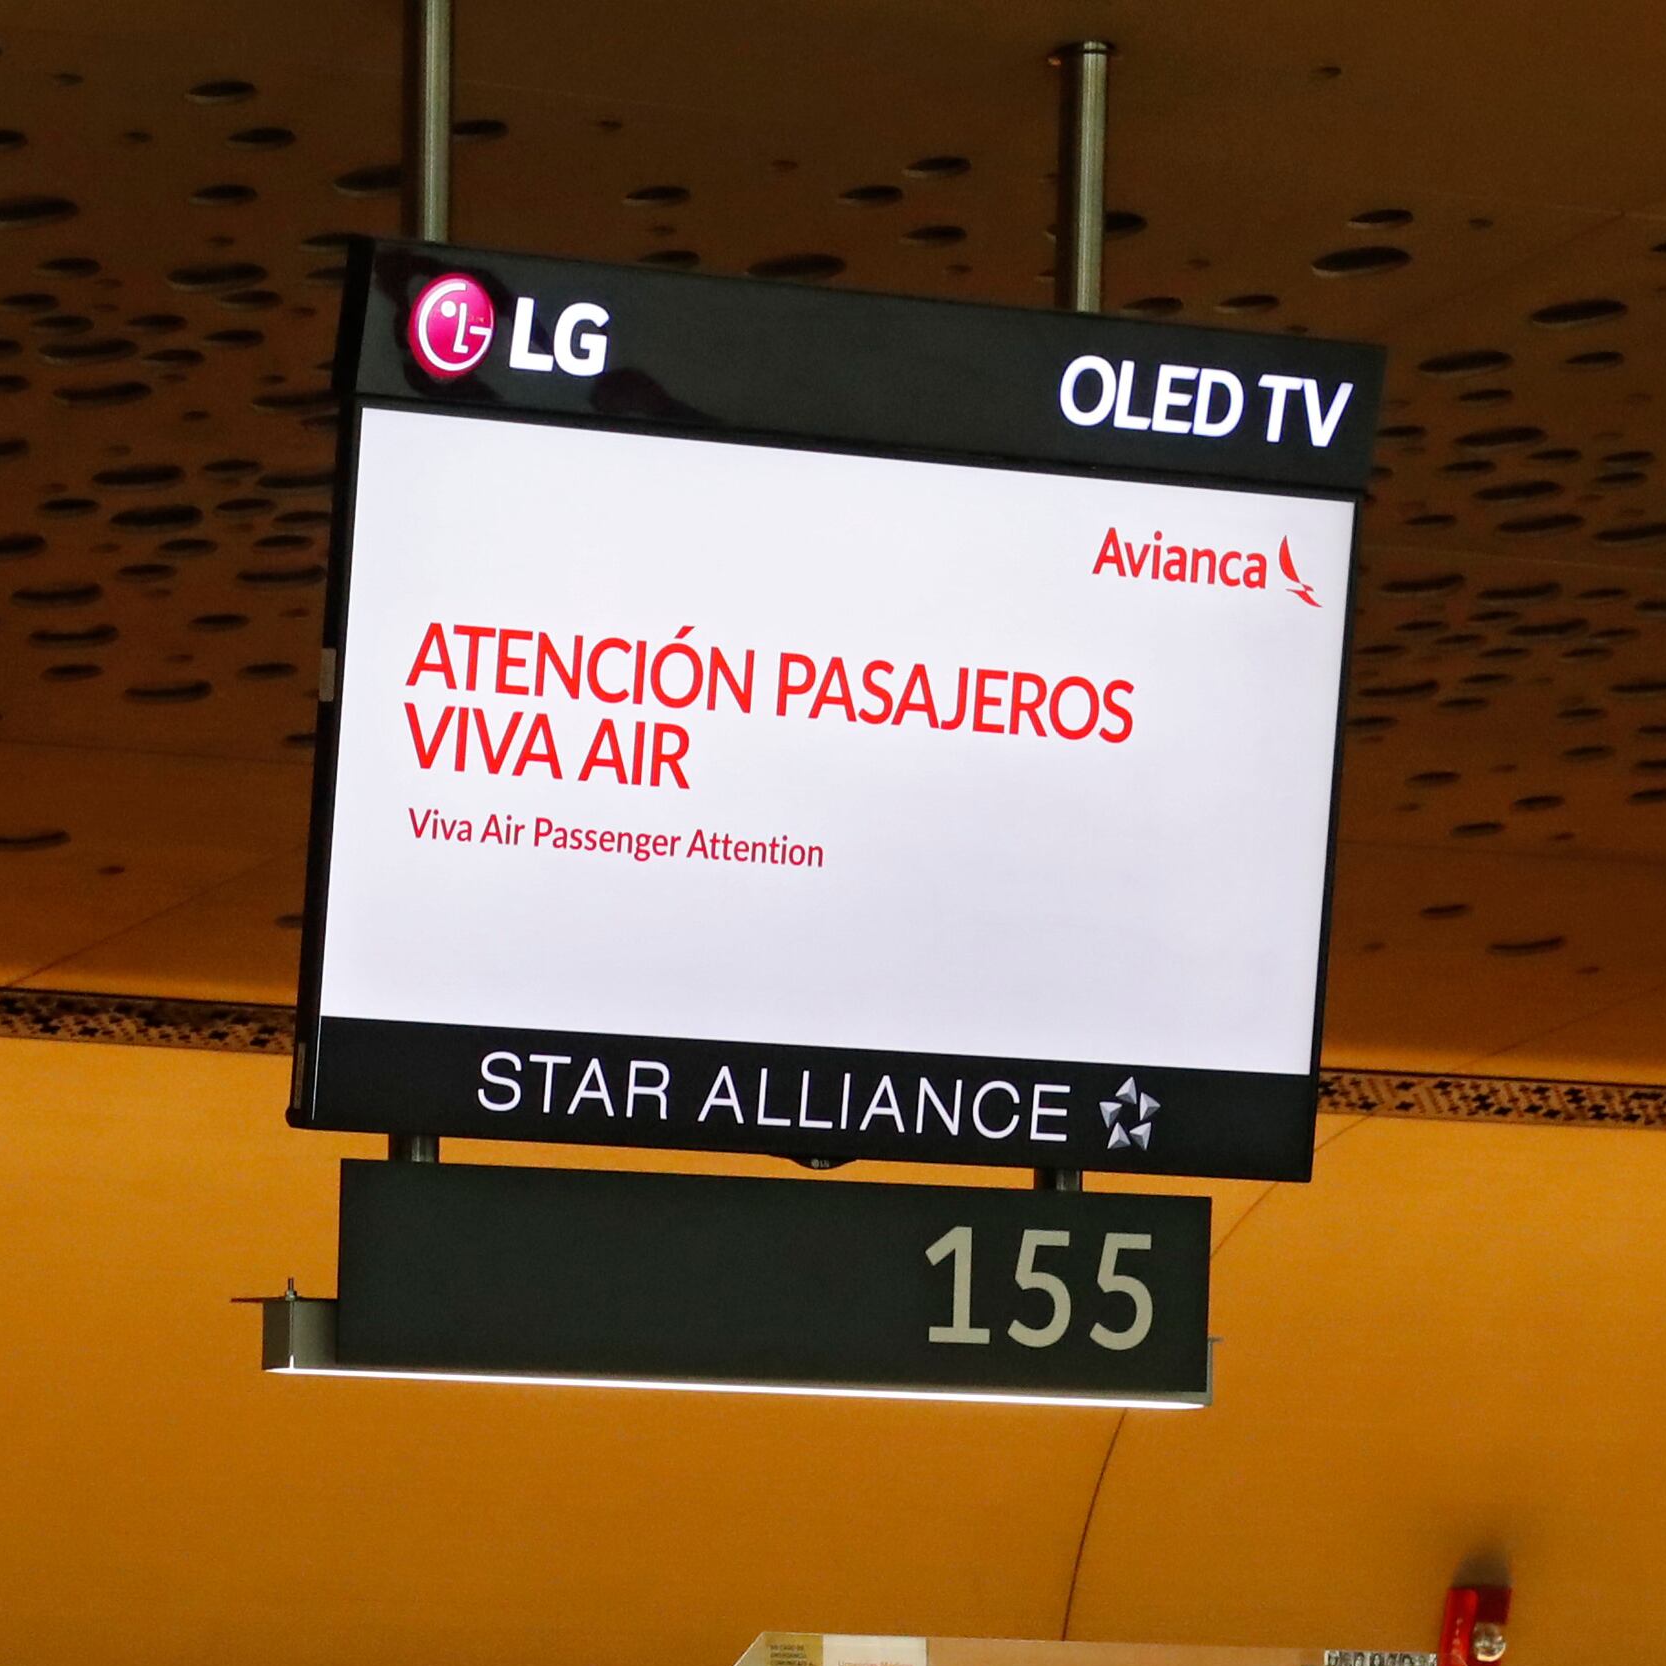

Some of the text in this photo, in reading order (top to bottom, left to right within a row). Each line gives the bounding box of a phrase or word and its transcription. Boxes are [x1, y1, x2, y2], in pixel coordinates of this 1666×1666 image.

[509, 297, 609, 377] LG
[1060, 355, 1353, 447] OLED TV
[1093, 527, 1268, 590] Avianca
[406, 623, 1134, 744] ATENCIÓN PASAJEROS
[404, 702, 689, 790] VIVA AIR
[408, 807, 824, 868] Viva Air Passenger Attention
[477, 1052, 1070, 1141] STAR ALLIANCE
[926, 1226, 1153, 1350] 155
